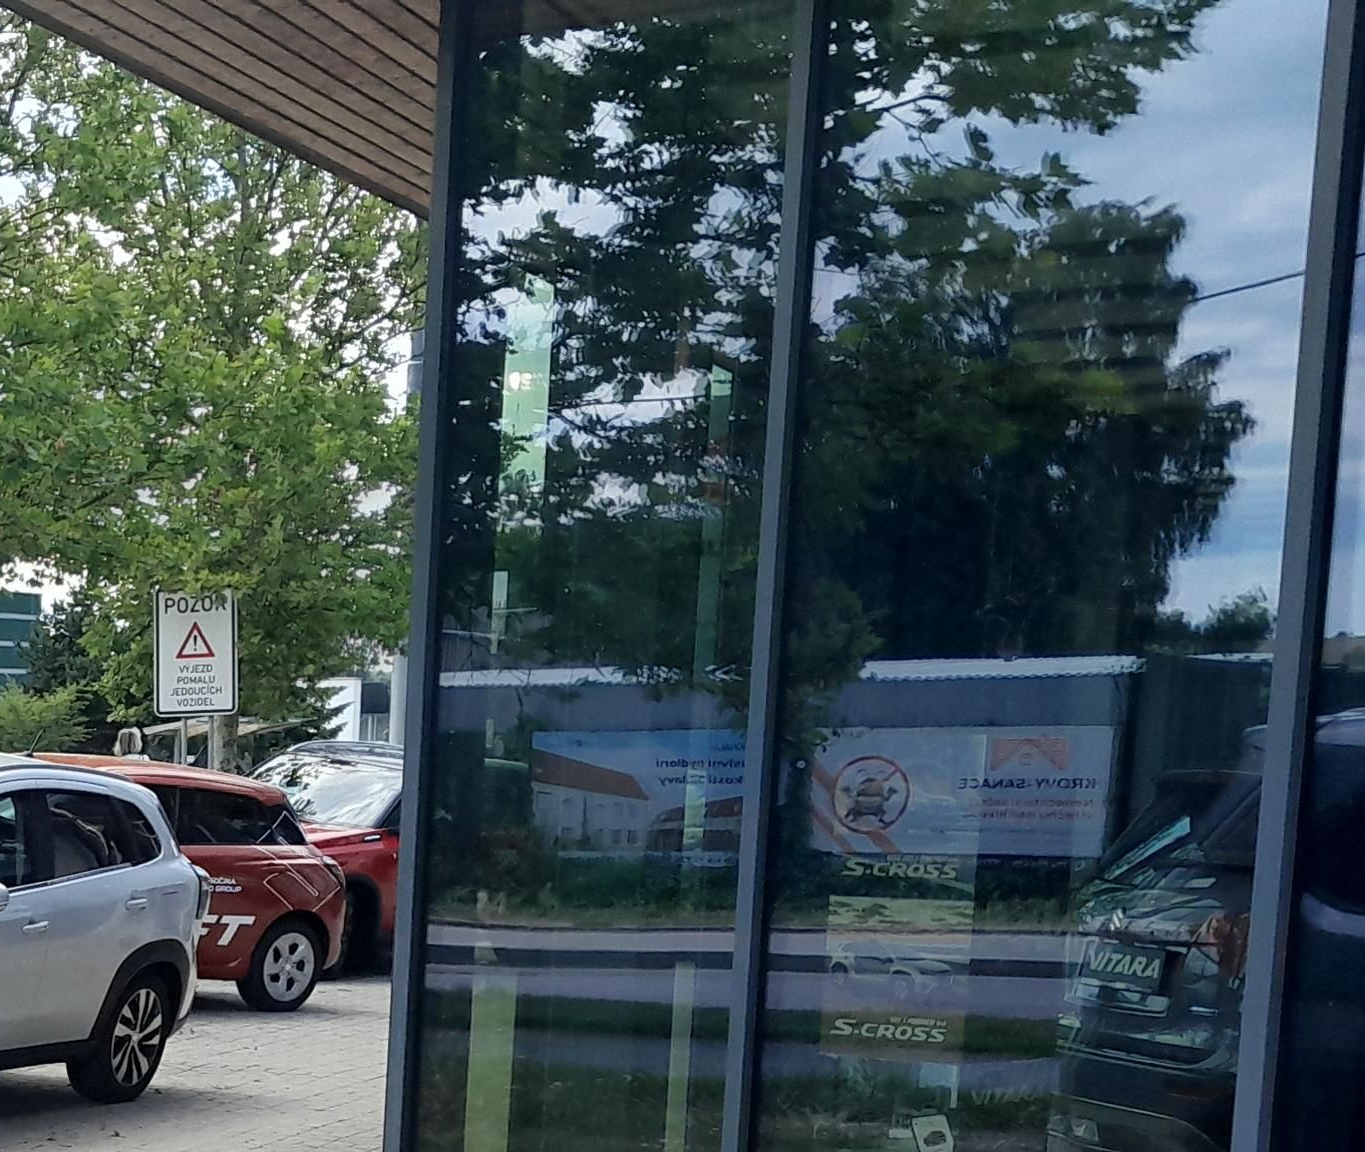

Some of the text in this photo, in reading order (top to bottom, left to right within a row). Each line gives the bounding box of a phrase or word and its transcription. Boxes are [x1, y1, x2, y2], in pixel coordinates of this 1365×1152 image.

[176, 675, 216, 685] POMALU
[170, 685, 222, 697] JEDOUCÍCH
[176, 697, 215, 707] VOZIDEL
[1088, 949, 1162, 980] VITARA
